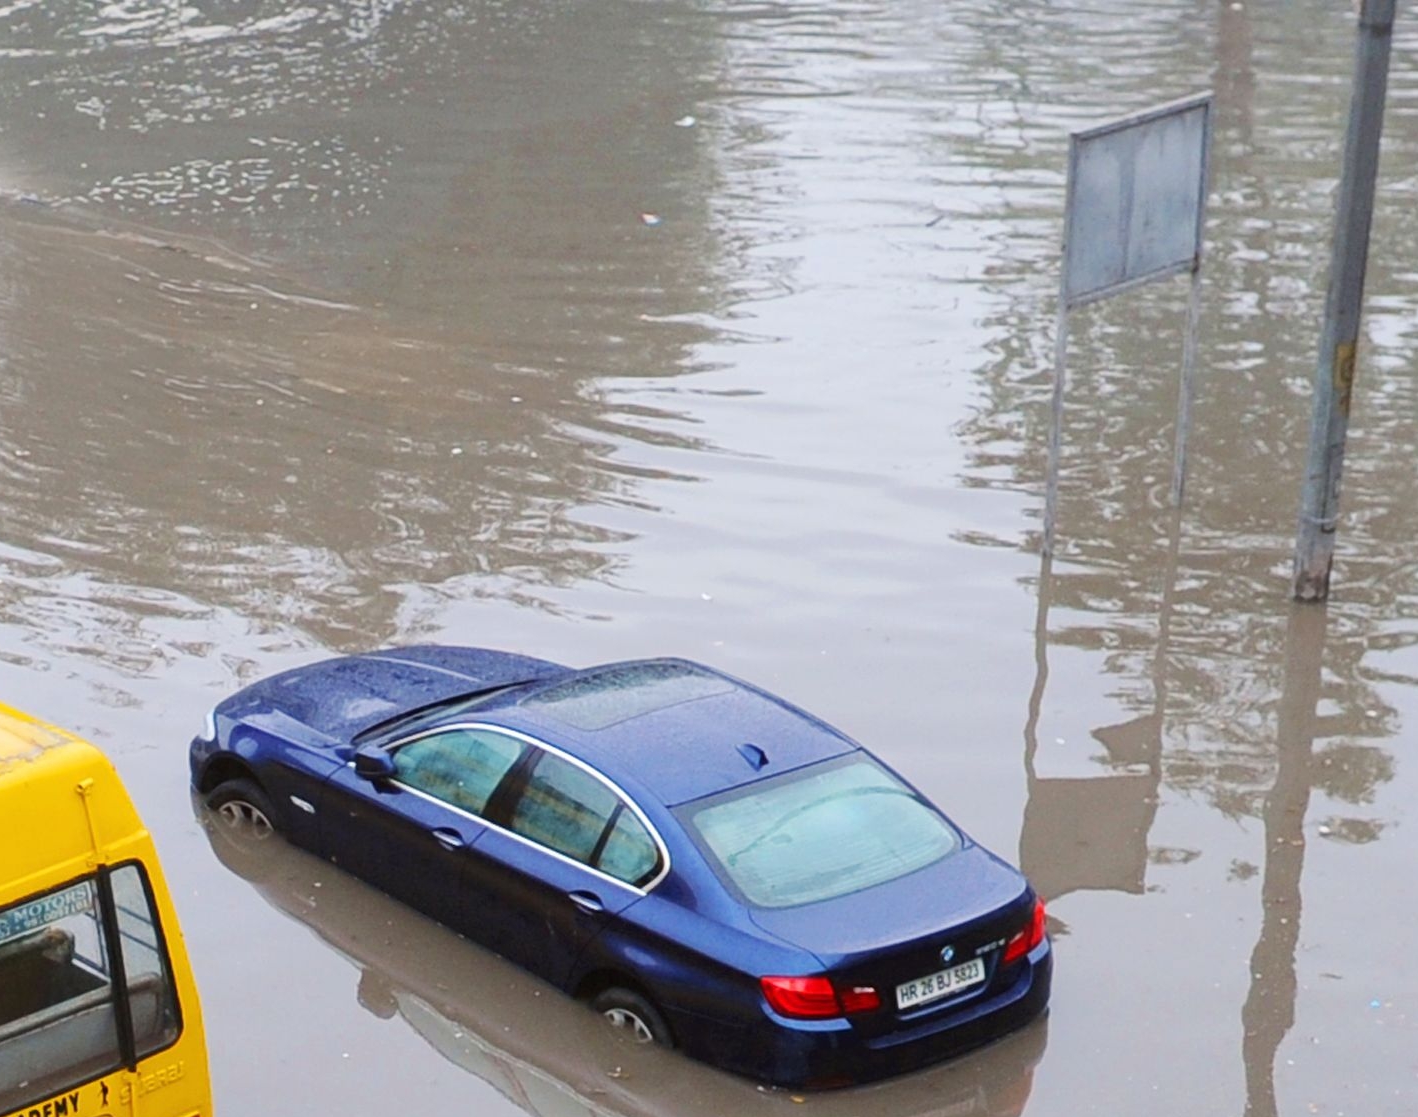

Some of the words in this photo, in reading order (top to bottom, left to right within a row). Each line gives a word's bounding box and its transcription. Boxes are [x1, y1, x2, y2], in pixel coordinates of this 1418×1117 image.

[14, 885, 87, 923] MOTORS
[899, 984, 919, 1004] HR
[919, 978, 934, 997] 26
[936, 972, 952, 992] BJ
[954, 962, 980, 985] 5823
